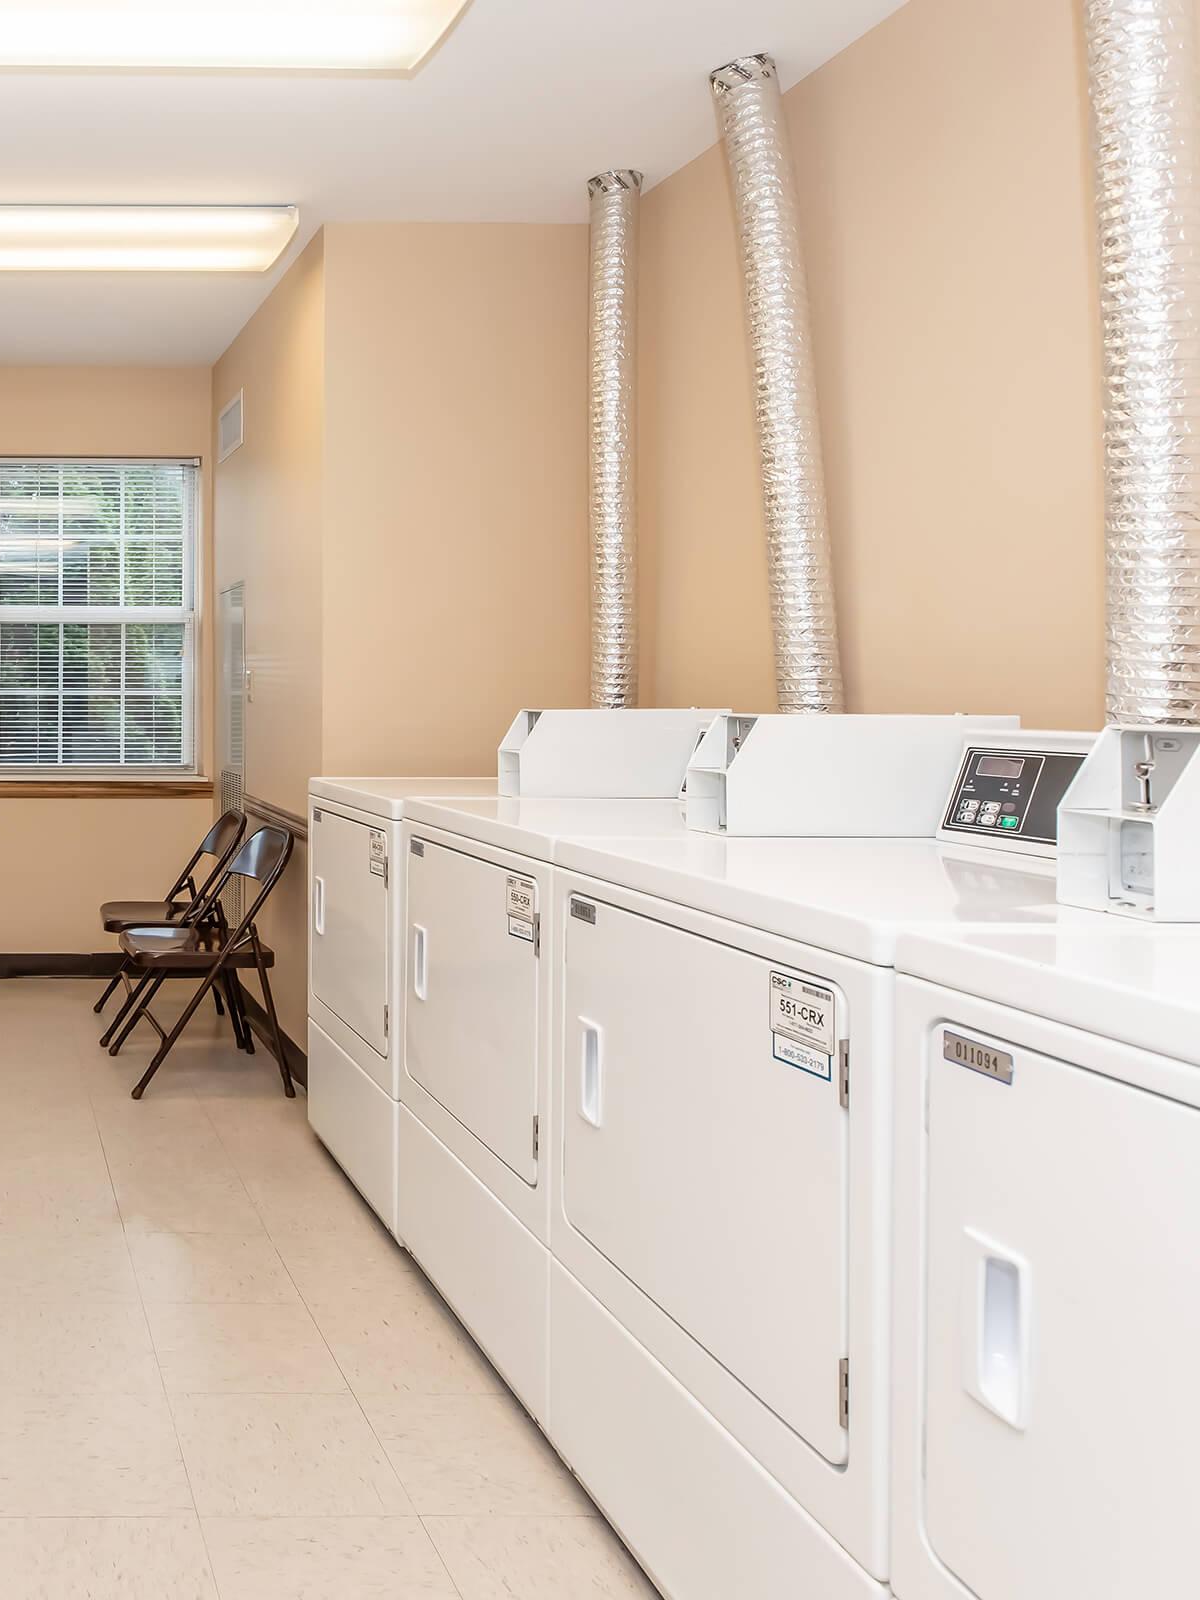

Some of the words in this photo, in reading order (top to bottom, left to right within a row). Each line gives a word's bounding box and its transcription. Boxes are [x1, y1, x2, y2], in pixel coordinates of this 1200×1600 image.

[772, 976, 787, 987] CSC
[780, 999, 824, 1027] 551-CRX
[956, 1041, 997, 1072] 011094
